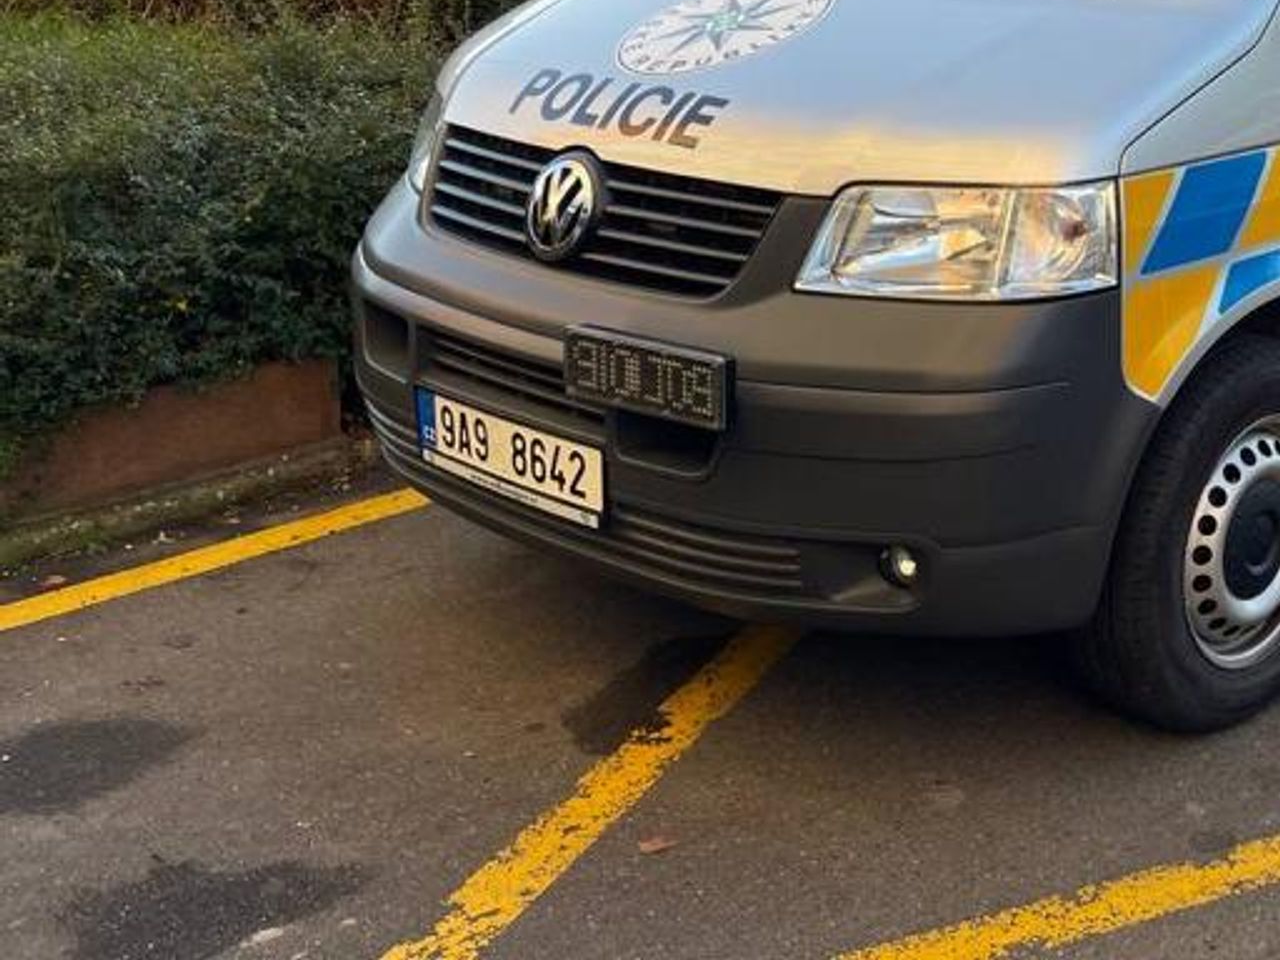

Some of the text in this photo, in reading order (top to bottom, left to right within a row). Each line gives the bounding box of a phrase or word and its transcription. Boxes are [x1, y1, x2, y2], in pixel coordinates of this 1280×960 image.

[508, 68, 730, 149] POLICIE
[440, 404, 490, 462] 9A9
[511, 431, 587, 499] 8642
